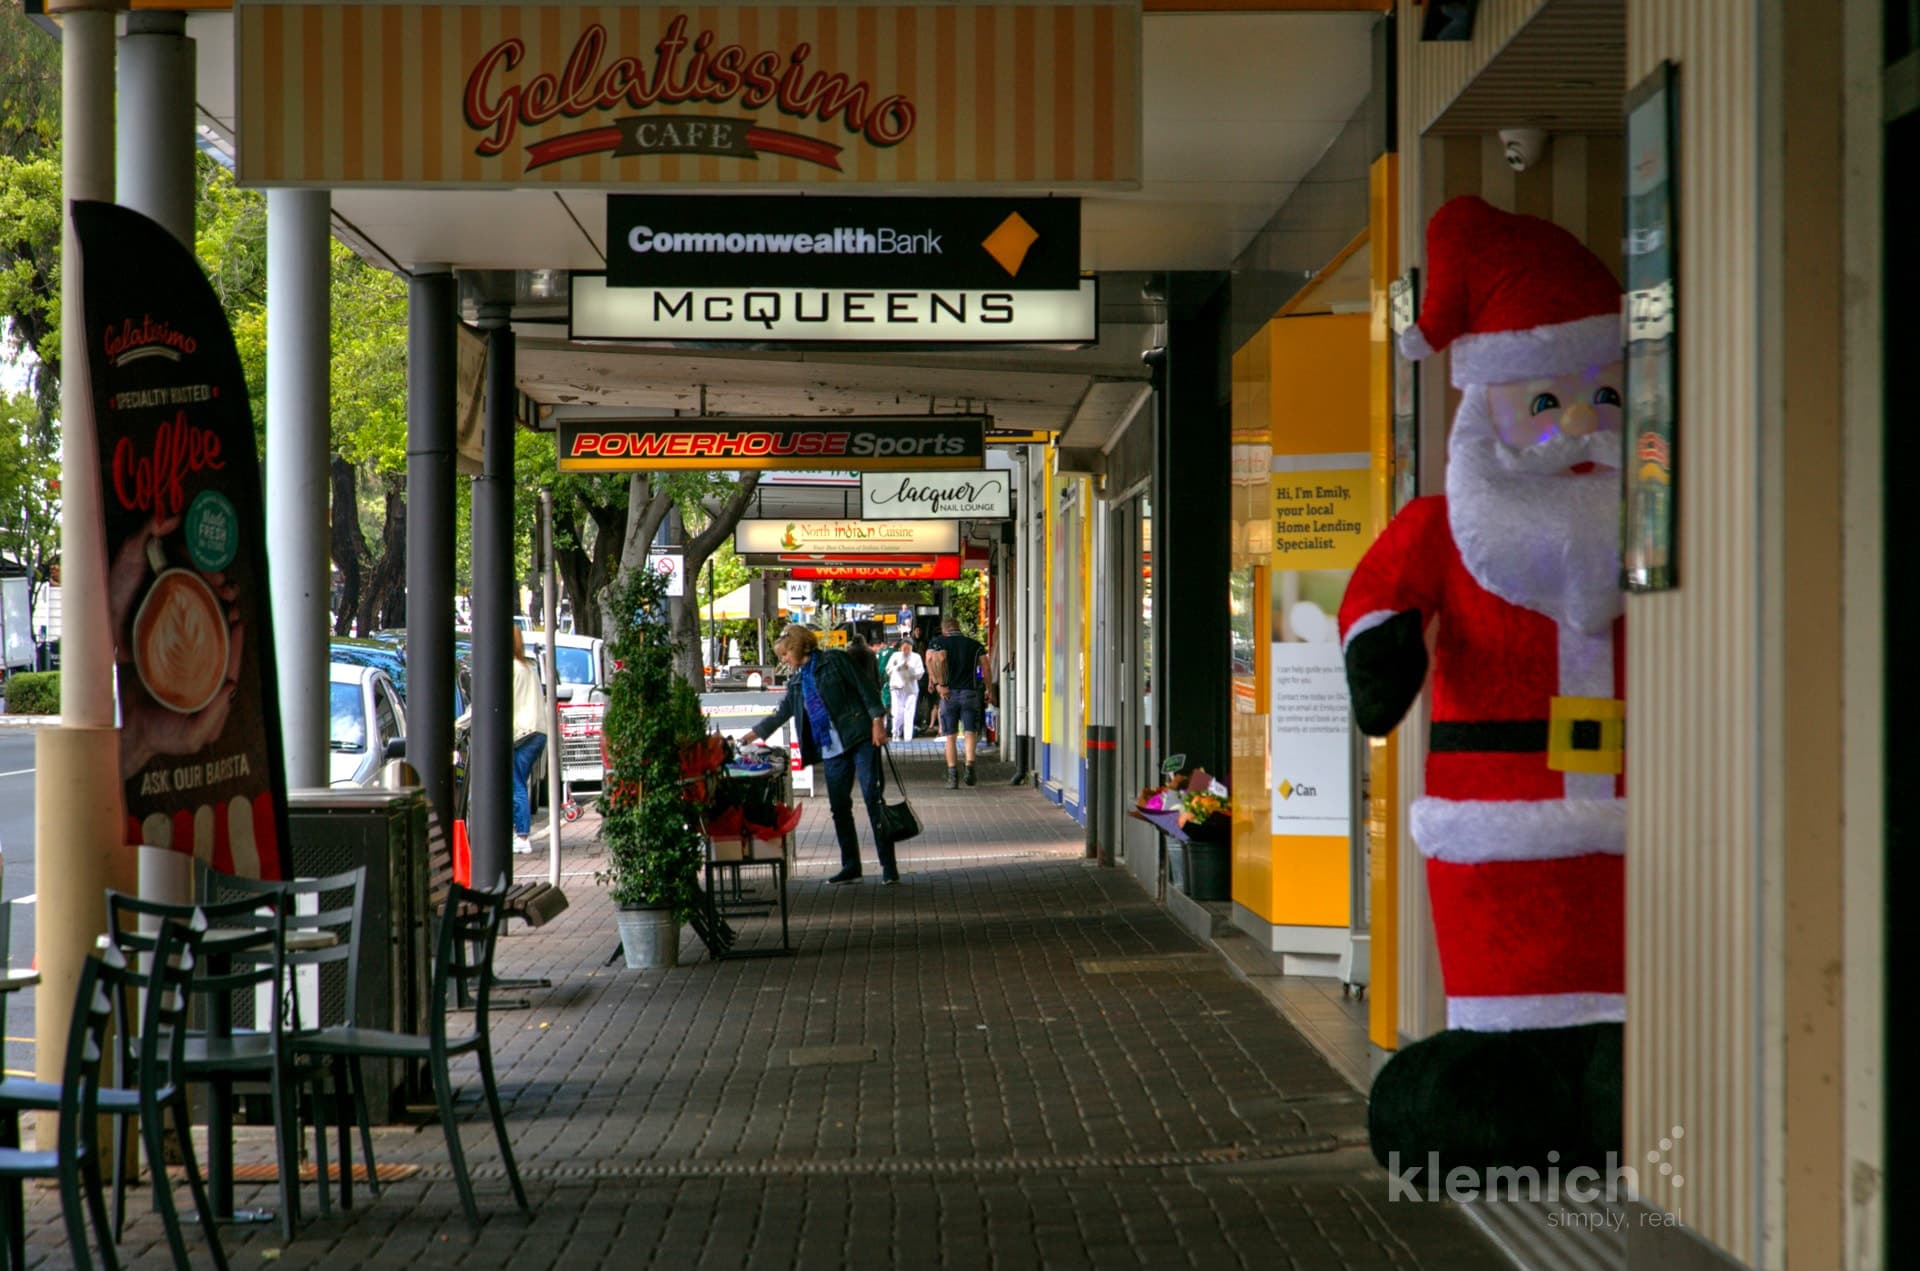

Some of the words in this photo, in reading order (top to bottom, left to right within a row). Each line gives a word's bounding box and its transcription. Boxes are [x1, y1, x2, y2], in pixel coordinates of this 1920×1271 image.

[464, 14, 917, 157] Gelatissimo
[635, 121, 735, 150] CAFE
[571, 432, 851, 456] POWERHOUSE
[851, 431, 966, 457] Sports
[112, 410, 225, 527] Coffee
[871, 477, 1001, 513] lacquer
[1277, 487, 1292, 501] Hi,
[1295, 487, 1312, 499] I'm
[1316, 486, 1351, 500] Emily,
[940, 503, 958, 511] NAIL
[960, 503, 995, 512] LOUNGE
[1277, 507, 1304, 518] your
[1306, 503, 1334, 516] local
[801, 524, 830, 537] North
[878, 524, 913, 537] Cuisine
[1277, 521, 1310, 533] Home
[1313, 520, 1361, 534] Lending
[1277, 537, 1336, 552] Specialist.
[790, 585, 807, 593] WAY
[141, 768, 170, 797] ASK
[173, 764, 203, 791] OUR
[1296, 783, 1317, 796] Can
